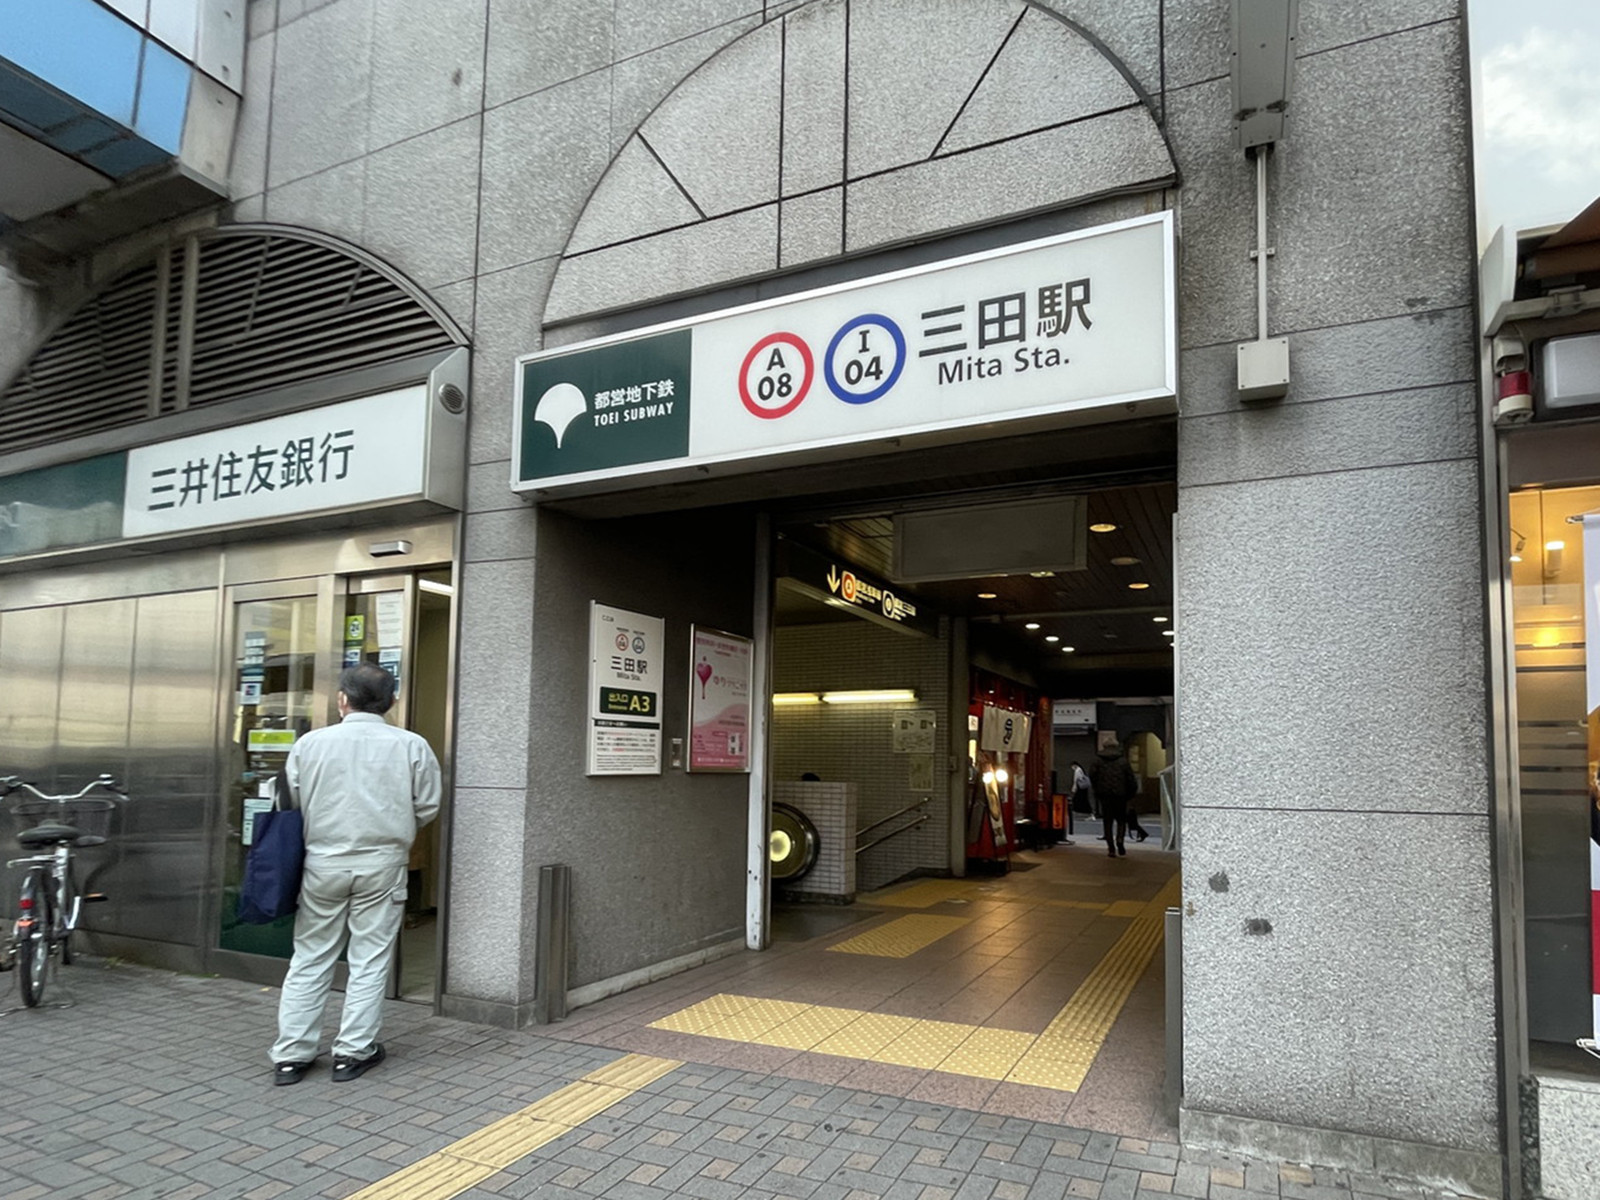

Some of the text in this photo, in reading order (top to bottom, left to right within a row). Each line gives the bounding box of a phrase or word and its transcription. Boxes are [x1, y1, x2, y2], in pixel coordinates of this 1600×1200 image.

[918, 277, 1092, 358] 三田駅
[859, 329, 871, 354] I
[766, 347, 786, 372] A
[844, 355, 883, 386] 04
[938, 347, 1070, 385] Mita Sta.
[594, 379, 675, 410] 都営地下鉄
[757, 372, 793, 401] 08
[593, 402, 674, 427] TOEI SUBWAY
[147, 429, 355, 511] 三井住友銀行
[611, 656, 648, 674] 三田駅
[629, 695, 650, 712] A3
